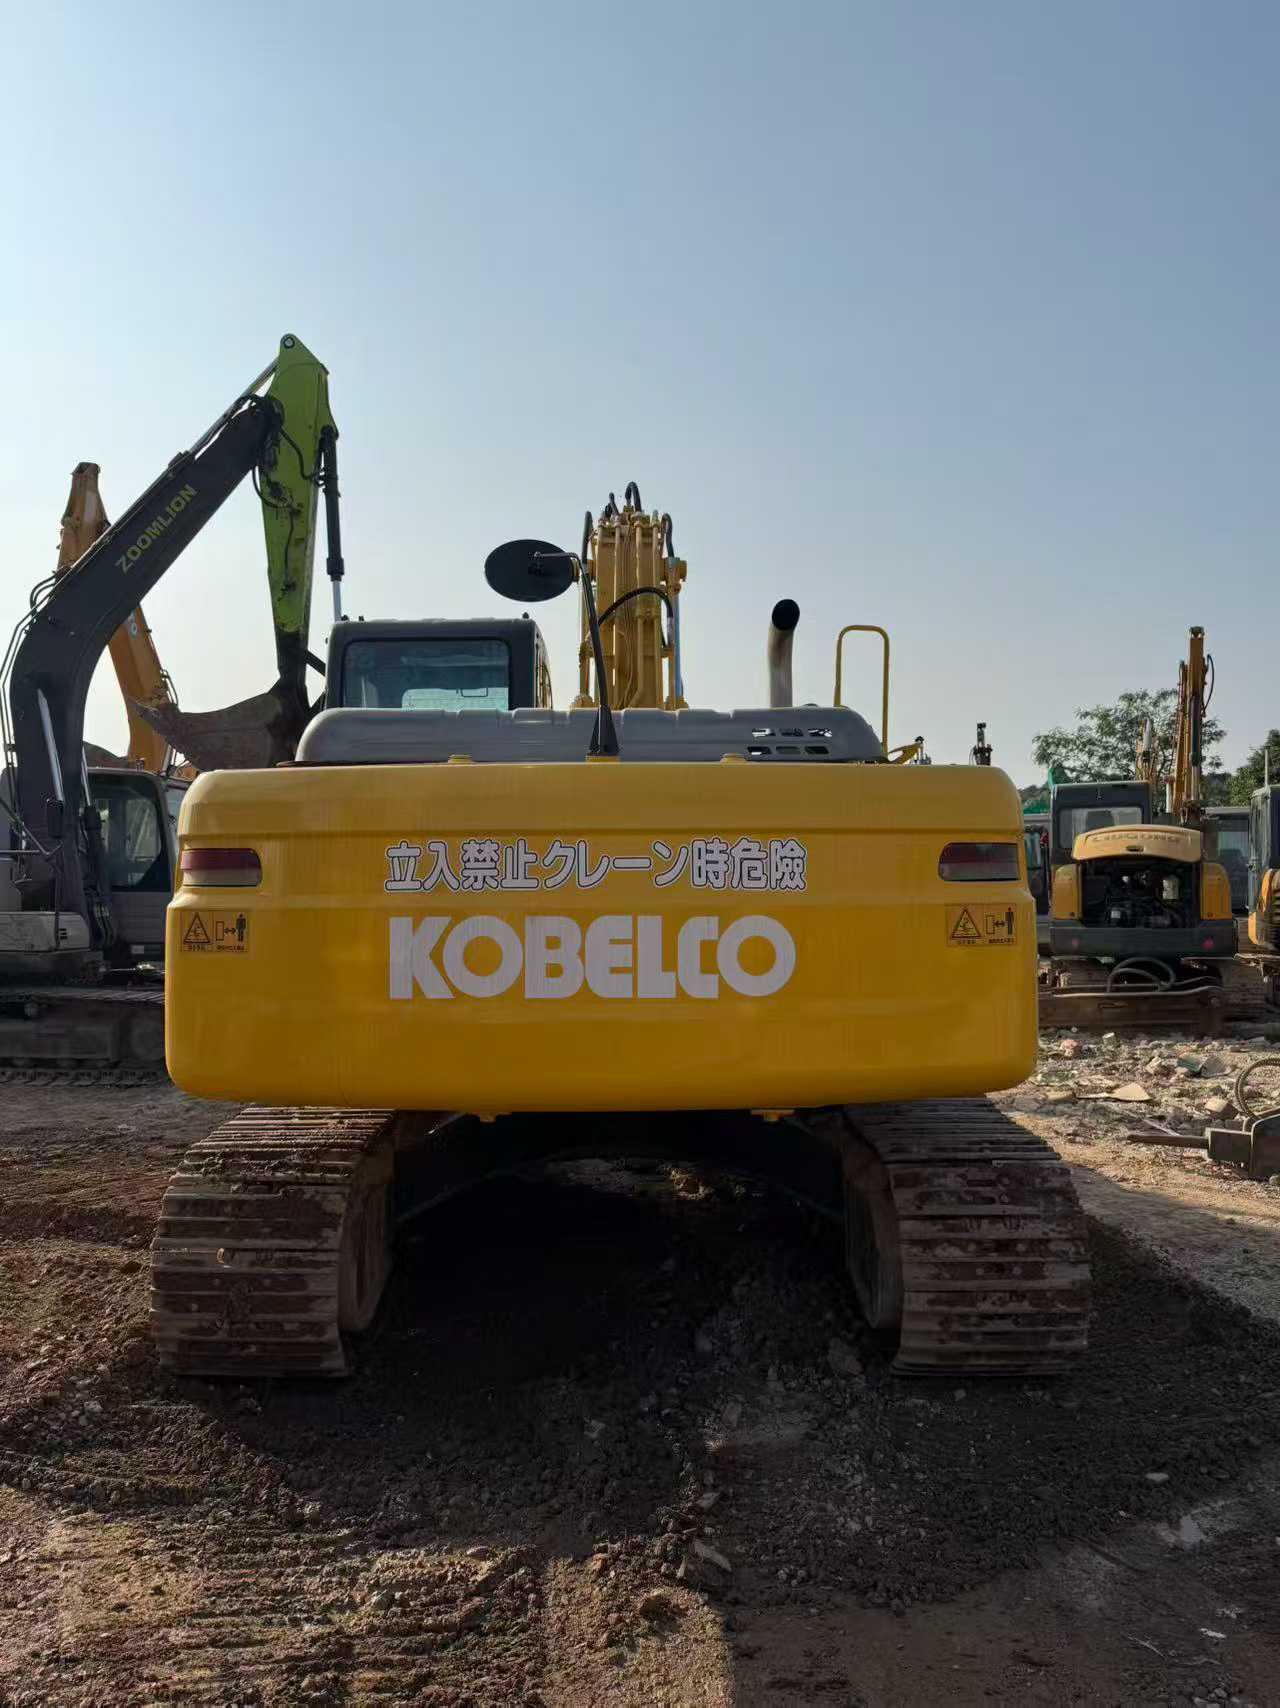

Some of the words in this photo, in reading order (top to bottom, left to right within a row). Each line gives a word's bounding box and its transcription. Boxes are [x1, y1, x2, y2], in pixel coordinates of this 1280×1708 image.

[116, 485, 197, 573] ZOOMLION
[385, 837, 807, 892] 立入禁止クレーン時危險
[389, 914, 797, 1000] KOBELCO
